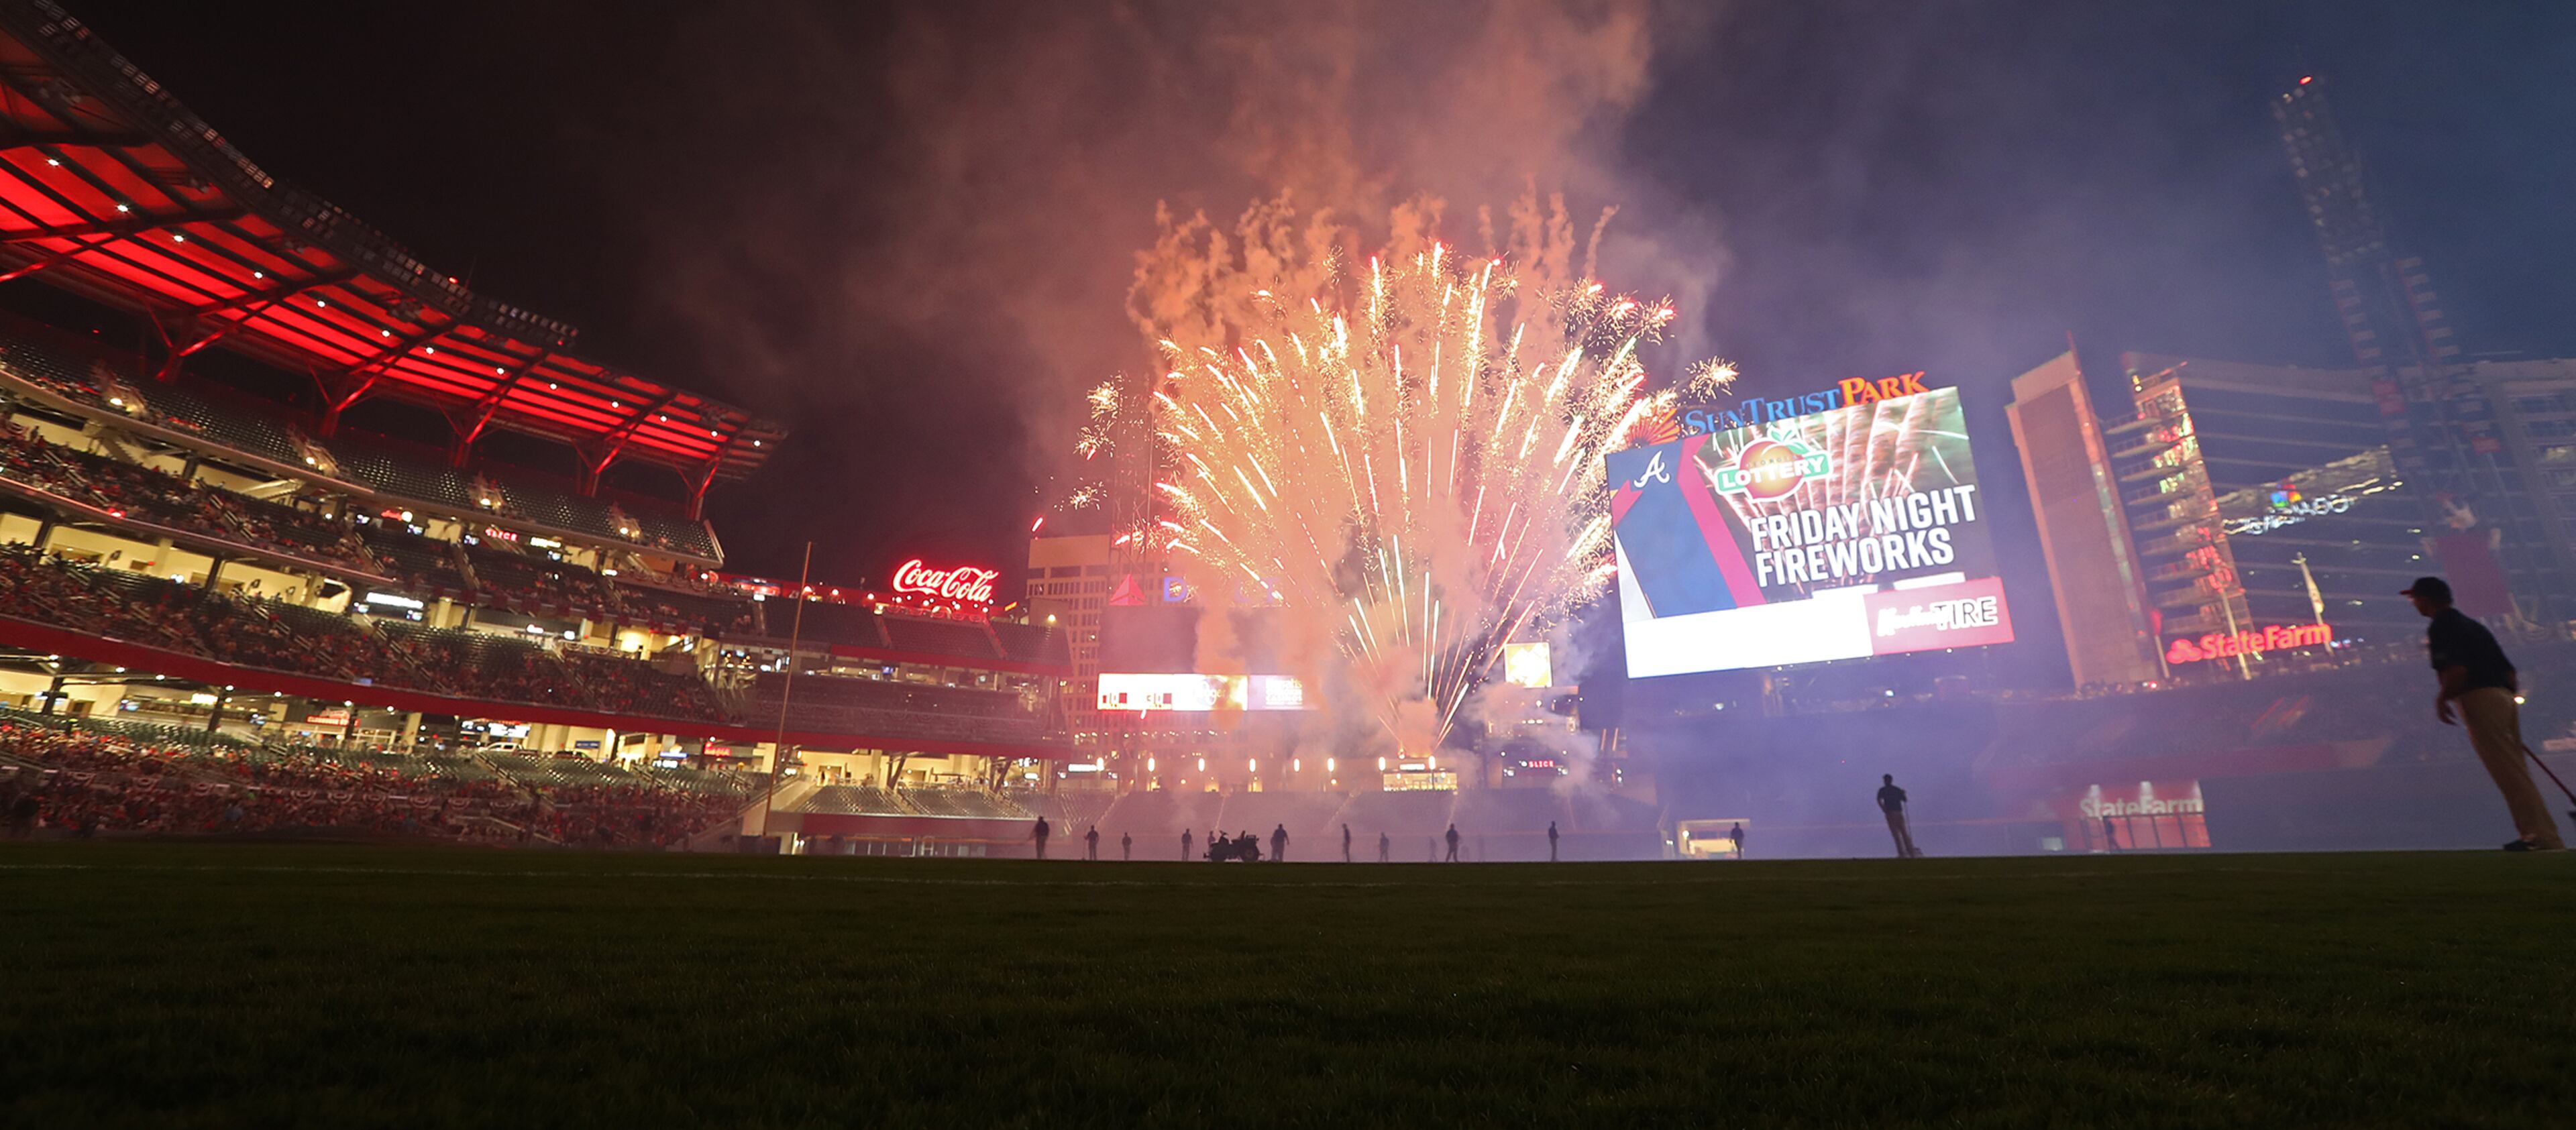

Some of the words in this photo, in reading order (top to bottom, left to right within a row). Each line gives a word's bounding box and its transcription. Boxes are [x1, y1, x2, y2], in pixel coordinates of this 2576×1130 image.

[1838, 371, 1929, 407] PARK
[1633, 450, 1670, 488] A
[1721, 455, 1825, 489] LOTTERY
[1750, 502, 1860, 552] FRIDAY
[1870, 484, 1976, 534] NIGHT
[1756, 527, 1955, 587] FIREWORKS
[893, 559, 999, 602] Coca-Cola
[1931, 596, 1998, 630] TIRE
[1528, 760, 1554, 768] SLICE
